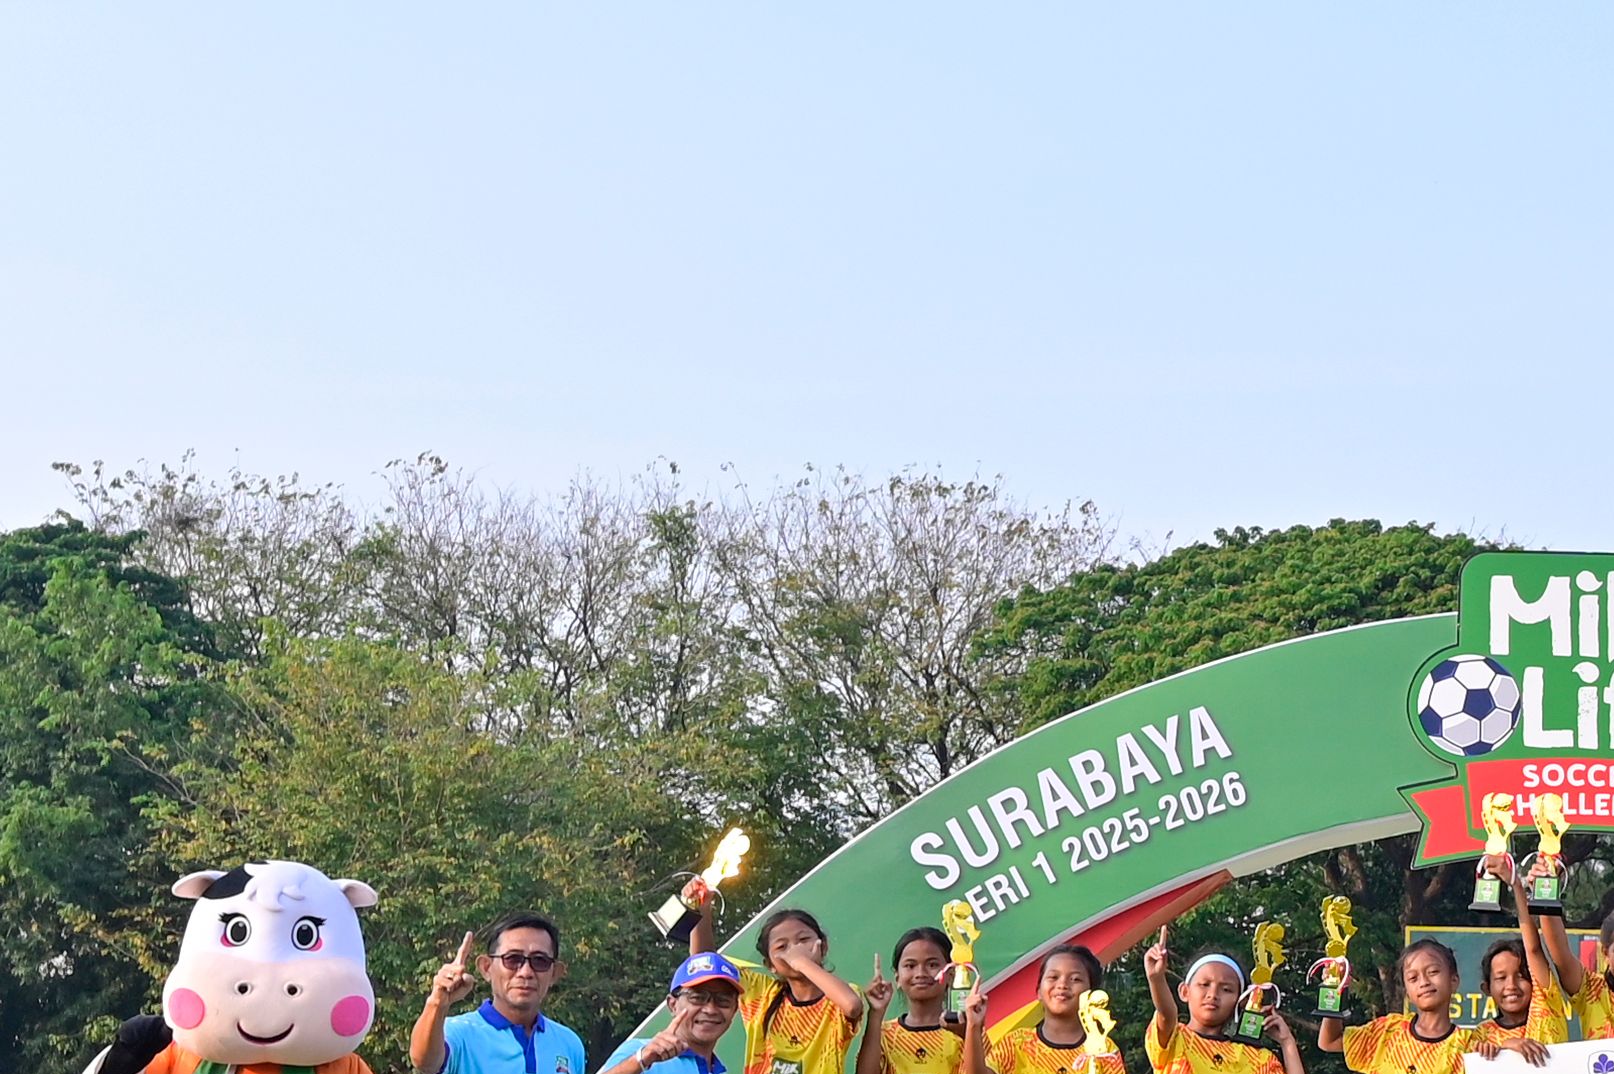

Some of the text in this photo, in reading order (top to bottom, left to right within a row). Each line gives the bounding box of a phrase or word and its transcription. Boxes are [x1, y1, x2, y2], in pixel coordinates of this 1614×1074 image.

[910, 705, 1232, 891] SURABAYA
[948, 771, 1247, 923] ERI 1 2025-2026
